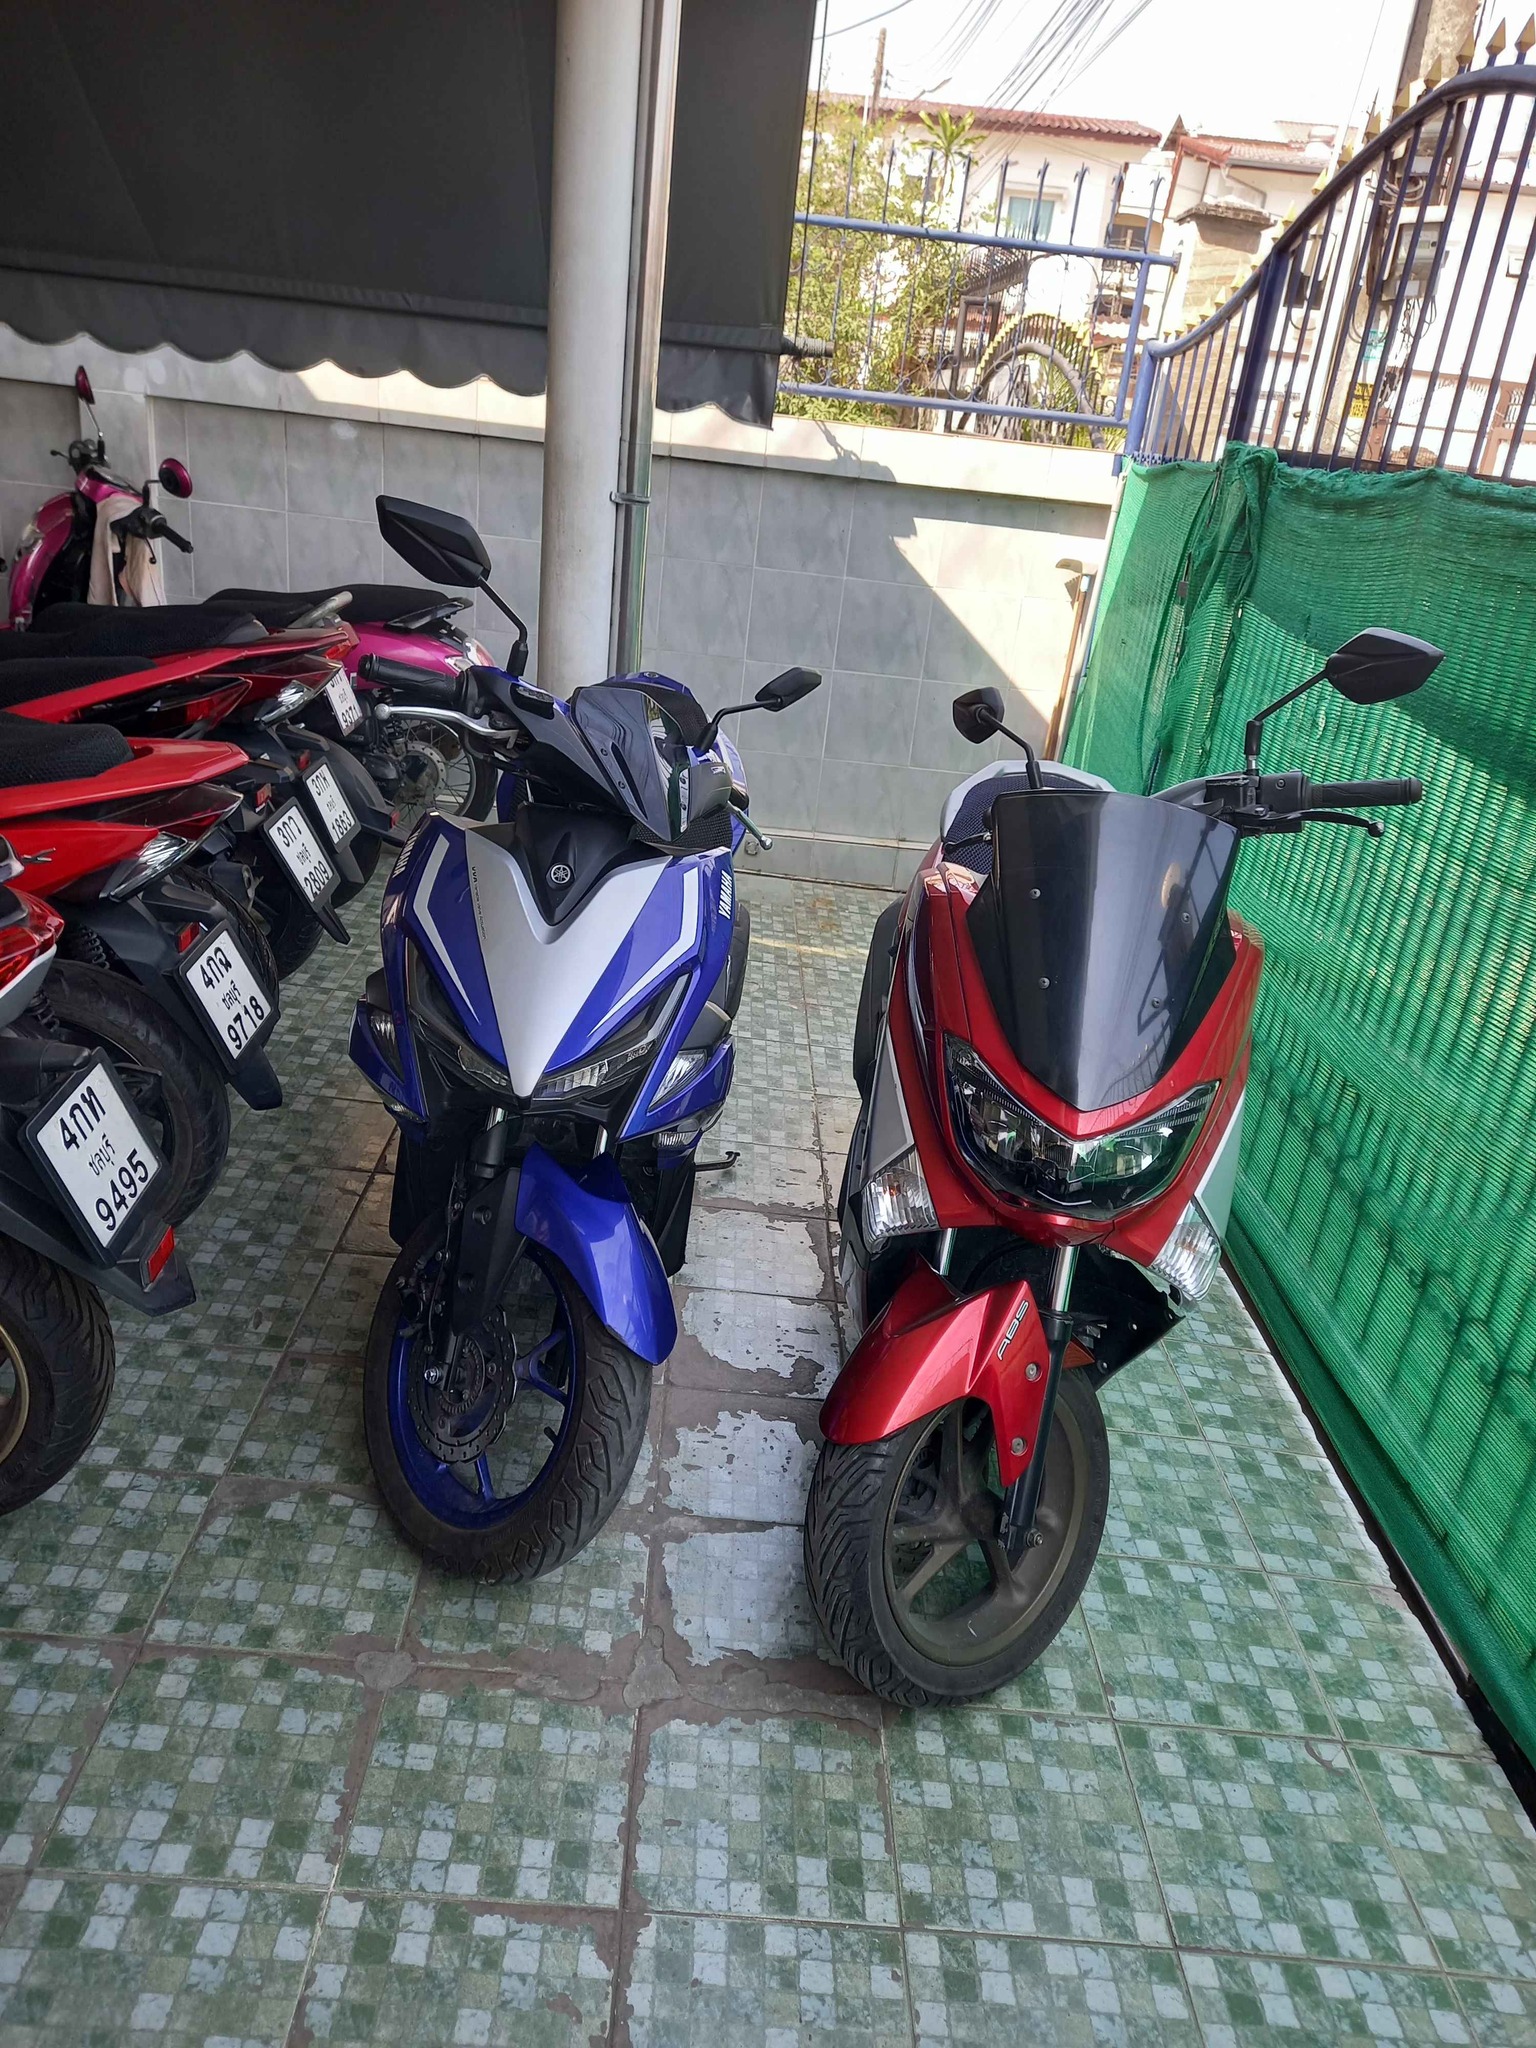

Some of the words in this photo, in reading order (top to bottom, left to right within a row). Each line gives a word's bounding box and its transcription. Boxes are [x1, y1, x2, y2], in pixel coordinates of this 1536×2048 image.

[331, 810, 352, 840] 1863
[303, 860, 330, 899] 2809
[718, 869, 733, 920] YAMAHA
[221, 979, 242, 1011] ชลบุรี
[227, 995, 265, 1050] 9718
[59, 1085, 106, 1151] 4กท
[88, 1132, 116, 1177] ชลบุรี
[95, 1148, 149, 1232] 9495
[997, 1300, 1029, 1360] ABS
